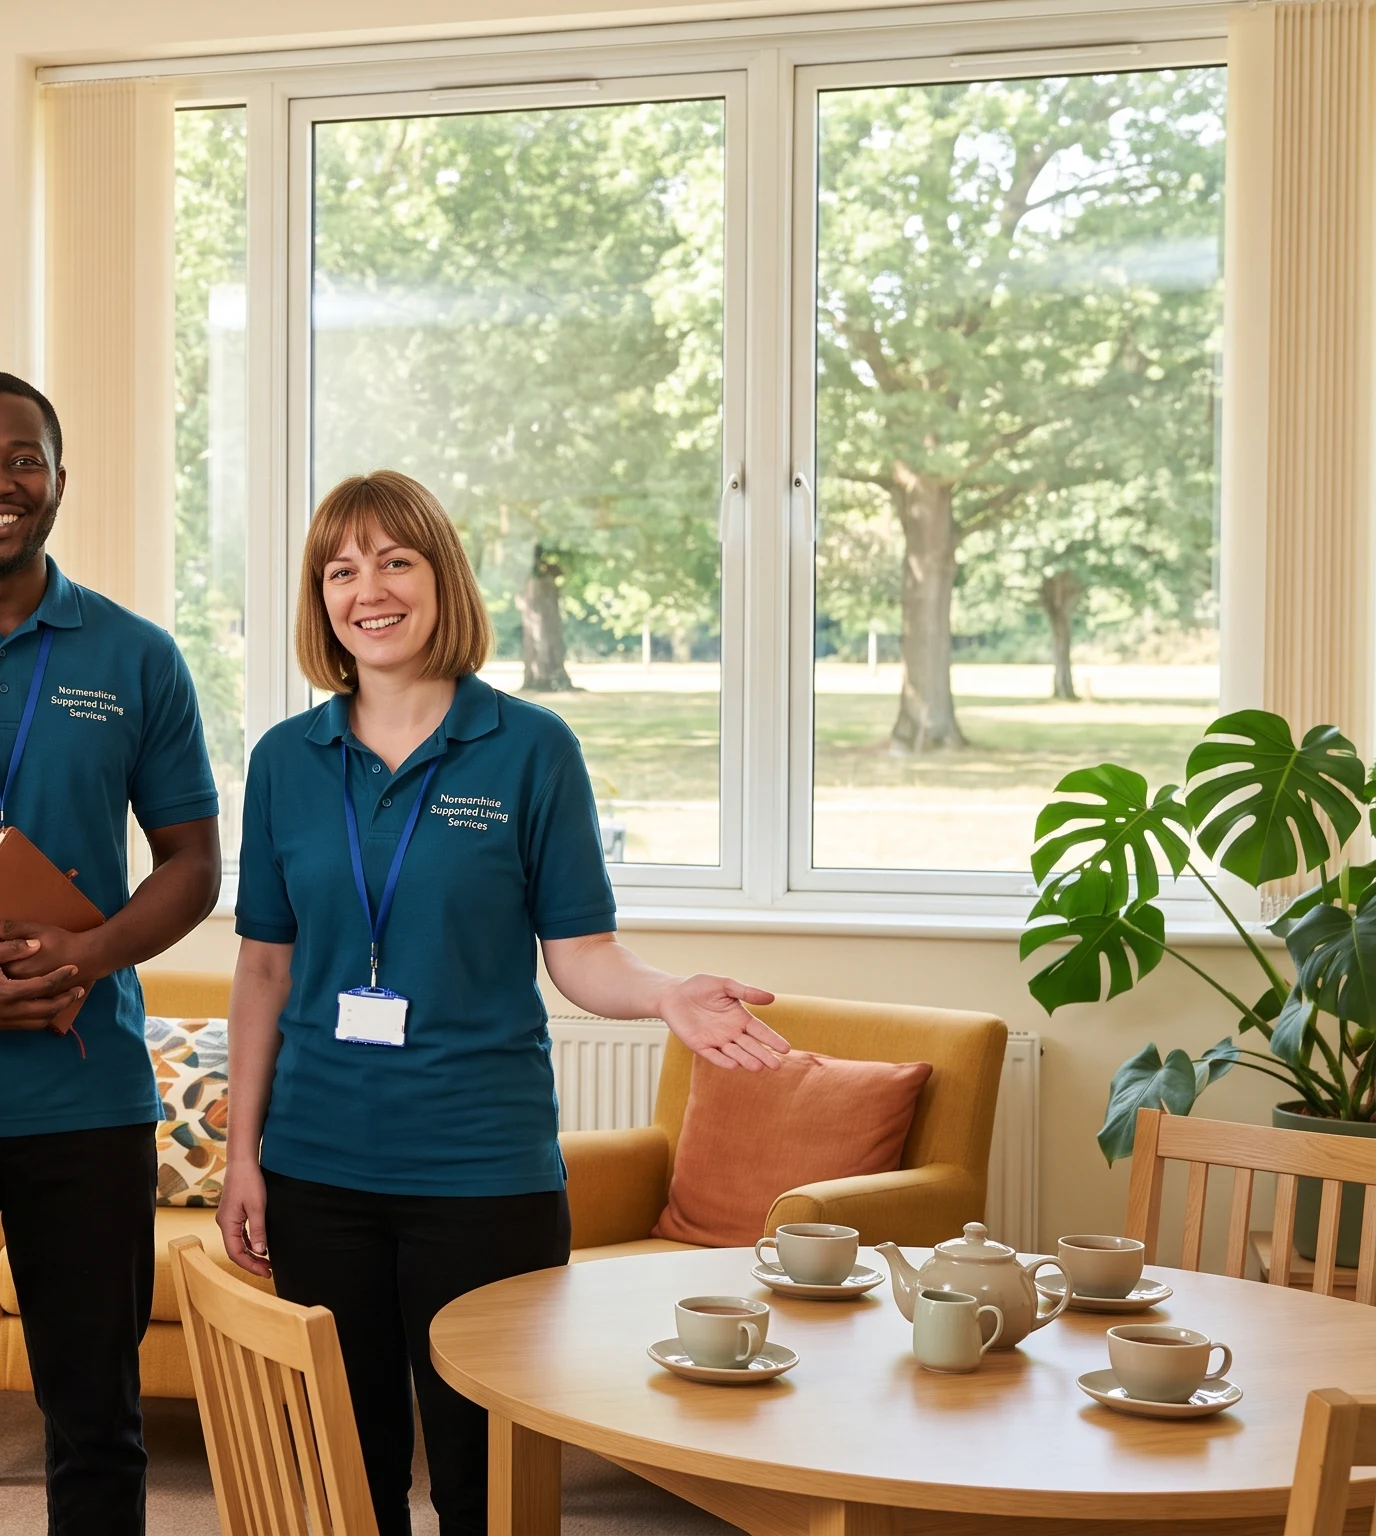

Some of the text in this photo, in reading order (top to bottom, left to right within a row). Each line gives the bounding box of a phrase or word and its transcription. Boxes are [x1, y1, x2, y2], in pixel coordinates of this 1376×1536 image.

[51, 696, 124, 715] Supported Living
[70, 709, 107, 721] Services
[431, 805, 479, 817] Supported
[448, 818, 488, 830] Services
